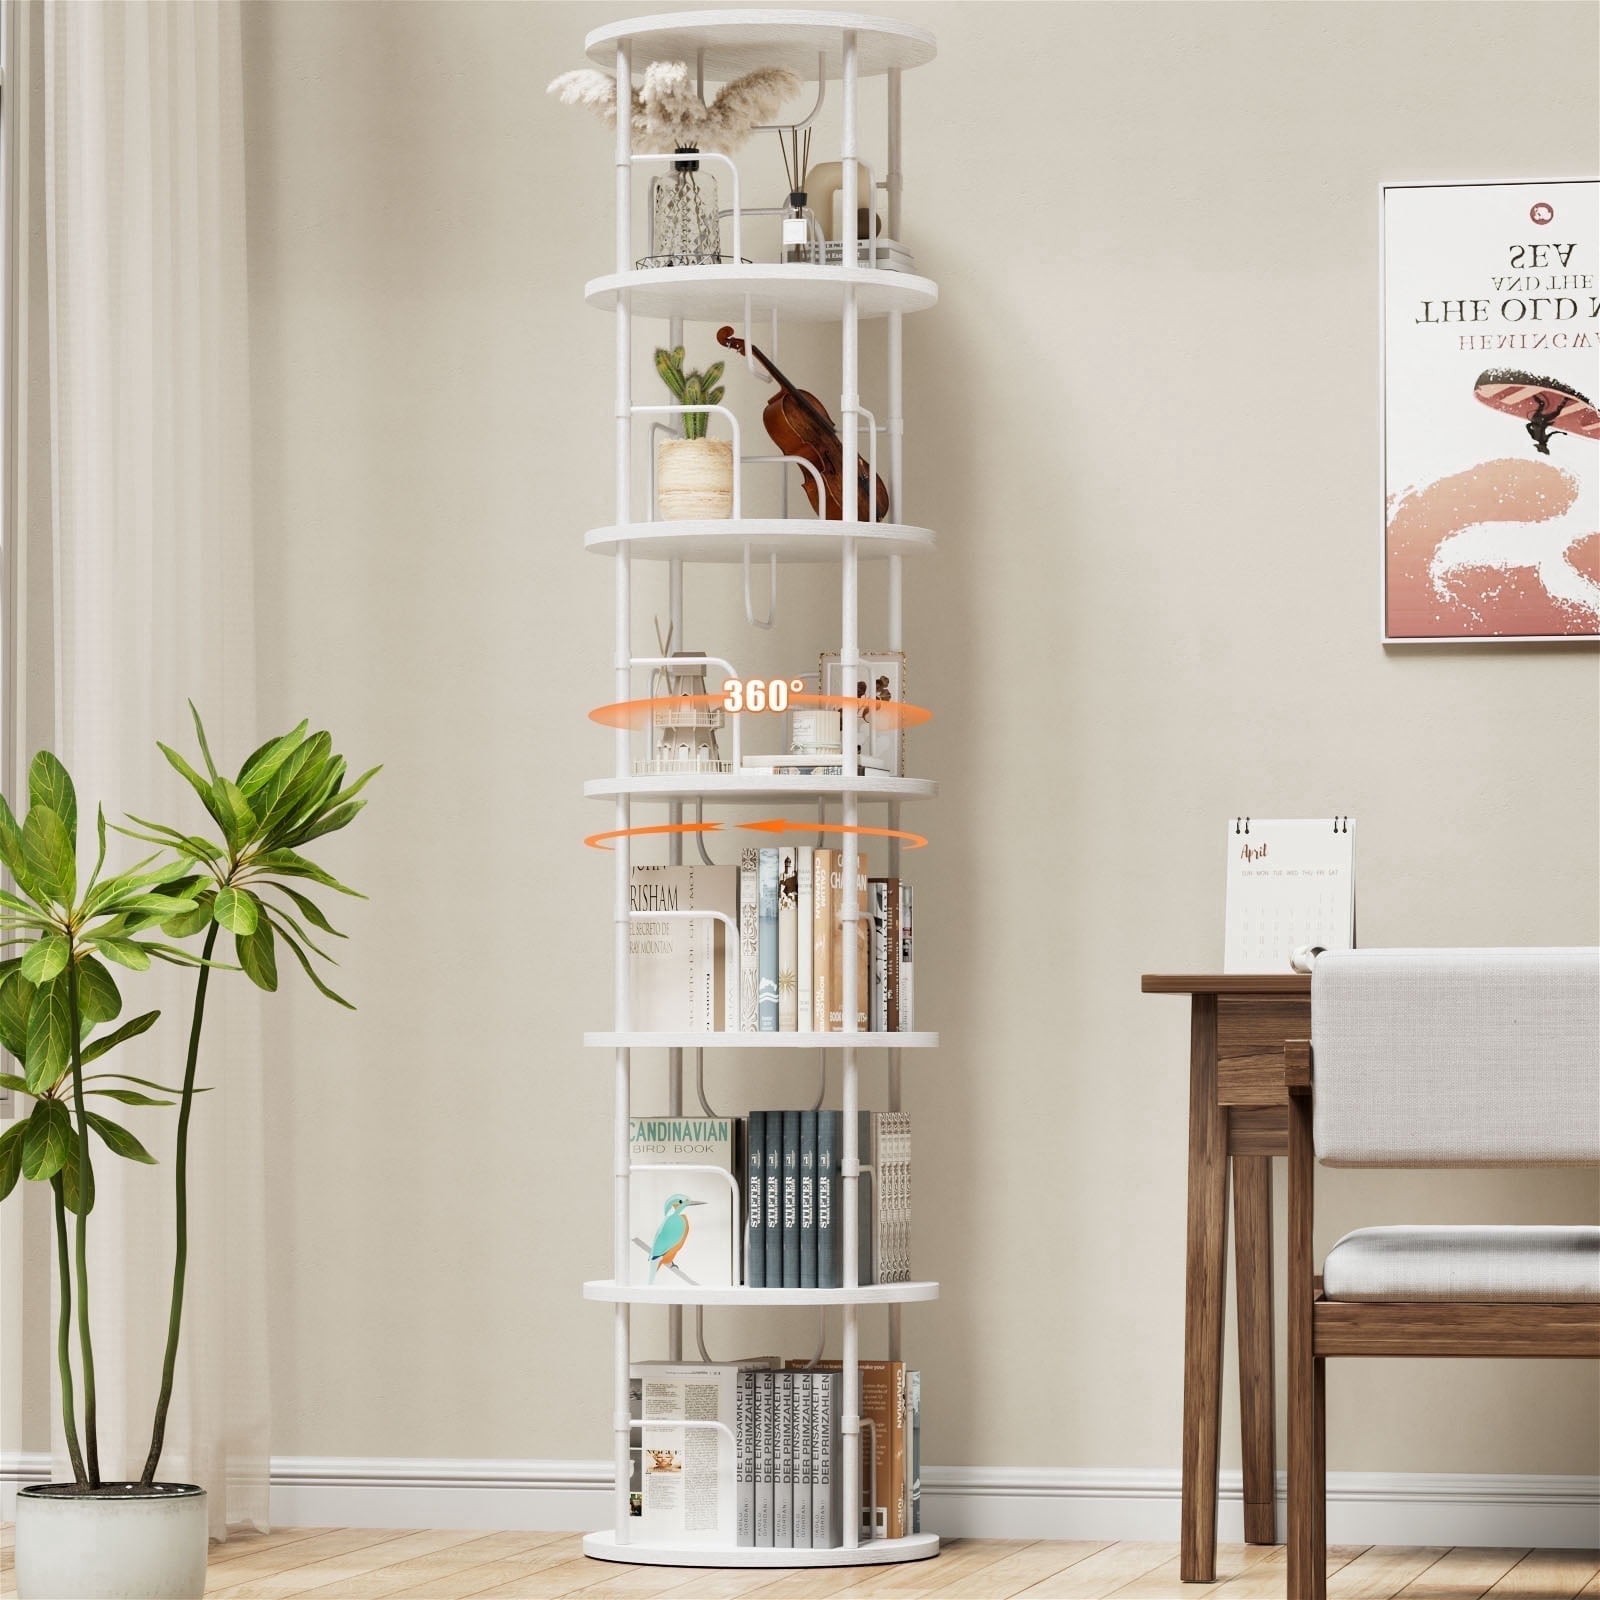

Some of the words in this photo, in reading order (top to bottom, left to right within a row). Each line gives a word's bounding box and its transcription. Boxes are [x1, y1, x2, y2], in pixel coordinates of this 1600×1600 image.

[1240, 843, 1268, 864] April
[630, 884, 679, 912] RISHAM
[630, 1120, 728, 1142] CANDINAVIAN
[632, 1144, 666, 1154] BIRD
[674, 1144, 715, 1154] BOOK
[802, 1176, 810, 1229] STIFTER
[745, 1373, 753, 1453] PRIMZAHLEN
[764, 1373, 772, 1454] PRIMZAHLEN
[783, 1374, 791, 1454] PRIMZAHLEN
[802, 1374, 810, 1455] PRIMZAHLEN
[821, 1375, 829, 1455] PRIMZAHLEN
[745, 1457, 753, 1483] DER
[764, 1458, 772, 1483] DER
[783, 1458, 791, 1484] DER
[802, 1459, 810, 1484] DER
[821, 1459, 829, 1485] DER
